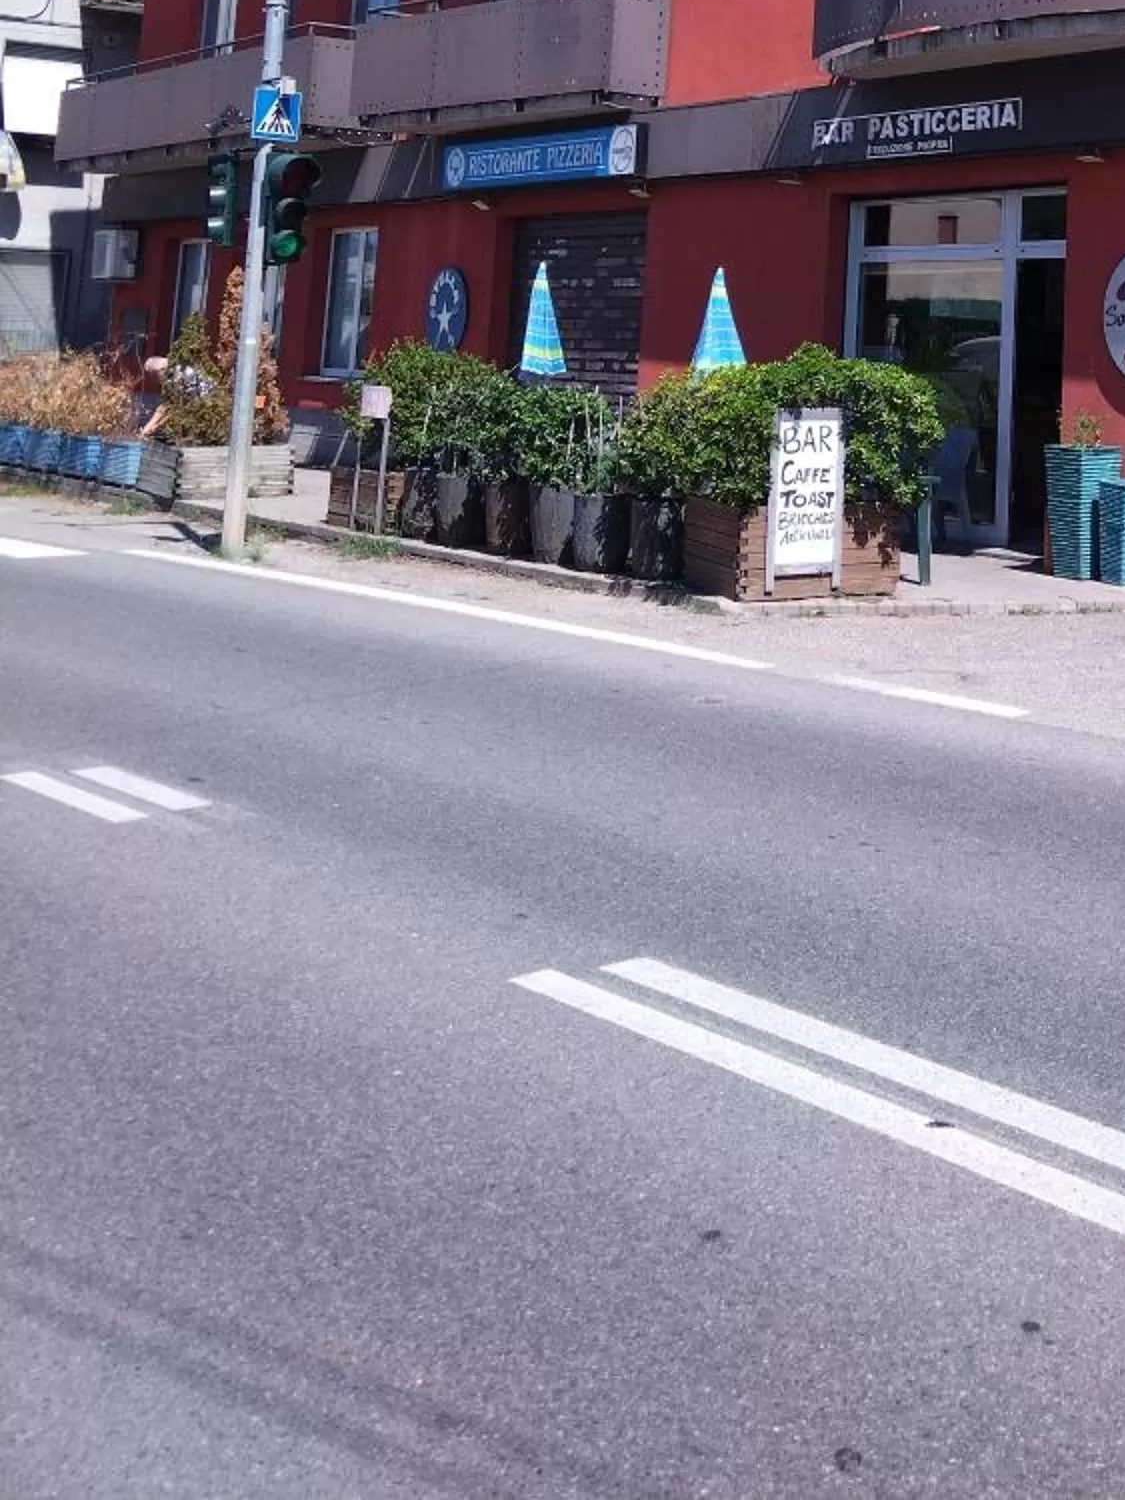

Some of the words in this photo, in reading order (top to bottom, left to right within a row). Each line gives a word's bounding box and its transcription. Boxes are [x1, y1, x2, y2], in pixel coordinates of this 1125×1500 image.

[813, 121, 855, 147] BAR
[867, 103, 1016, 140] PASTICCERIA
[469, 148, 540, 176] RISTORANTE
[547, 141, 603, 169] PIZZERIA
[783, 425, 833, 455] BAR
[780, 489, 835, 509] TOAST
